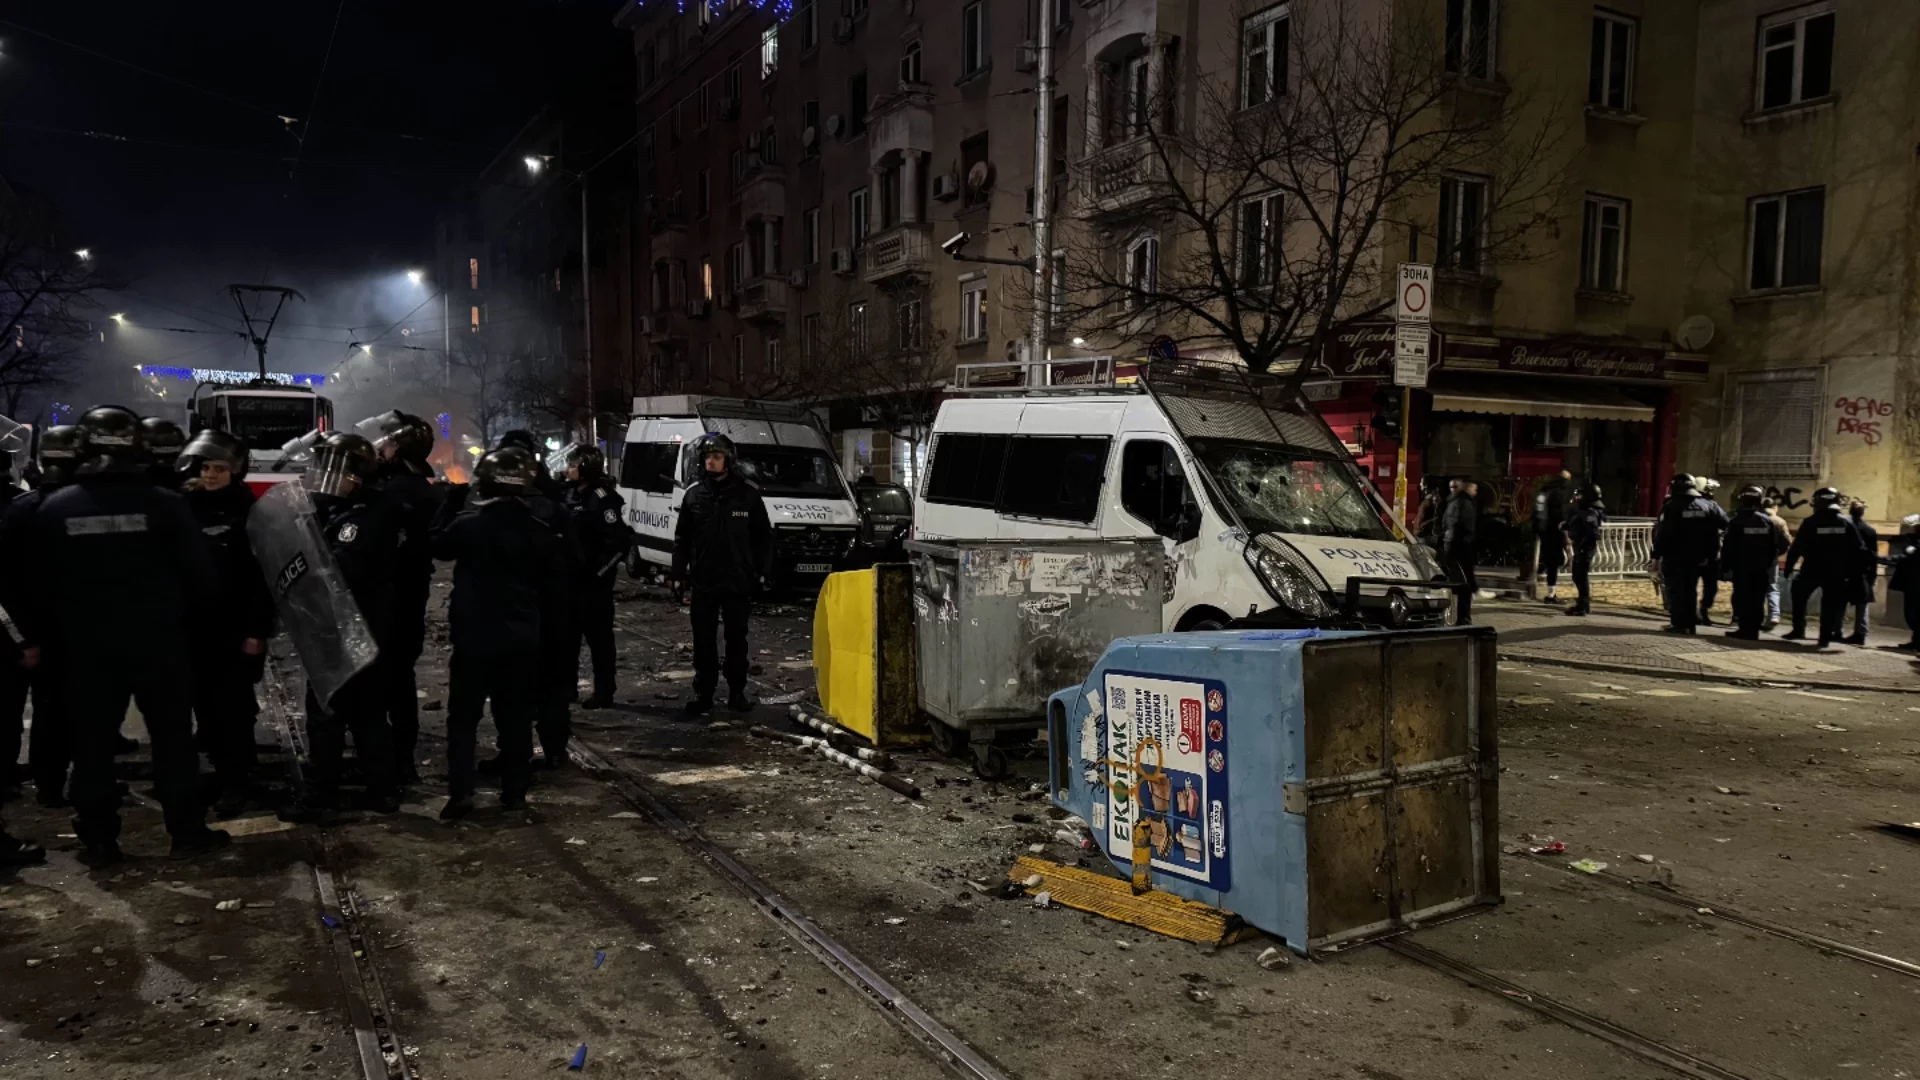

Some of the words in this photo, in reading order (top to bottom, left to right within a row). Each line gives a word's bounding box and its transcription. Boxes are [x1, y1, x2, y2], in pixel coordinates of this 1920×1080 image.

[1403, 267, 1429, 280] ЗОНА
[773, 504, 832, 512] POLICE
[629, 509, 669, 528] ПОЛИЦИЯ
[1320, 548, 1408, 563] POLICE
[1354, 562, 1408, 577] 24-1149
[1135, 697, 1144, 748] АРТИЕНИ
[1144, 690, 1153, 750] КРТОНЕНИ
